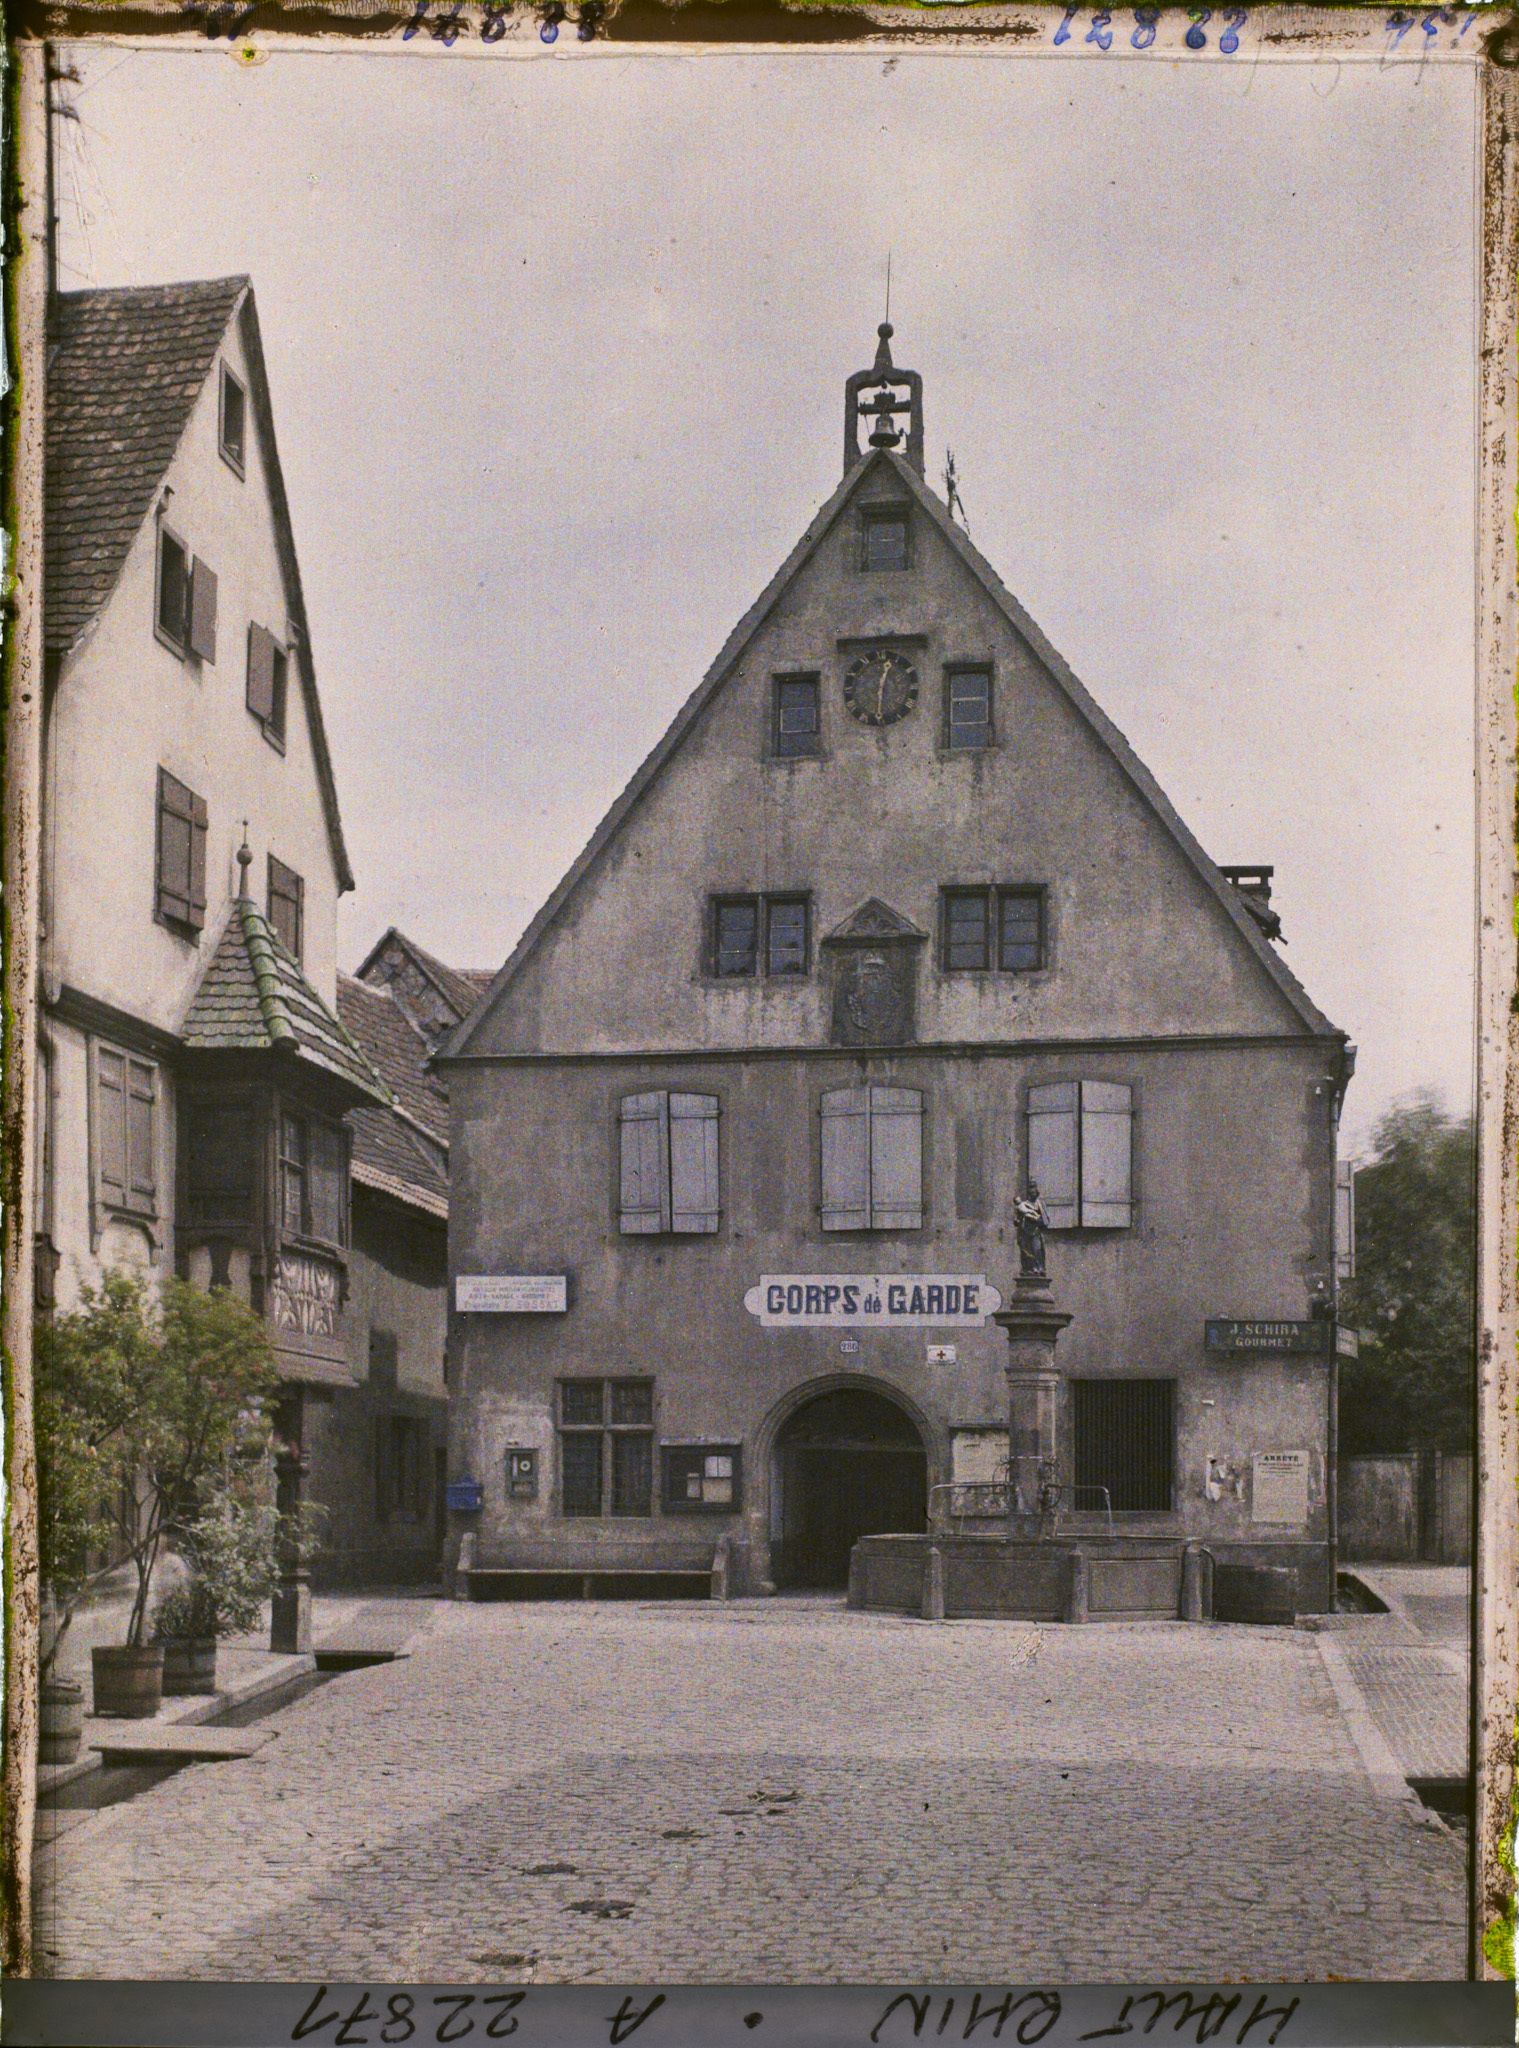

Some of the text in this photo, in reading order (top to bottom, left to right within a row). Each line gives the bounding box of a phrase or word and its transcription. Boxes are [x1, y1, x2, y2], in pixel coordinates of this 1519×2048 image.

[766, 1284, 860, 1315] CORPS
[887, 1284, 980, 1314] GARDE
[1235, 1338, 1293, 1348] GOURMET
[290, 1985, 527, 2046] 22871
[605, 1993, 667, 2045] A
[1076, 1991, 1301, 2045] HAUT
